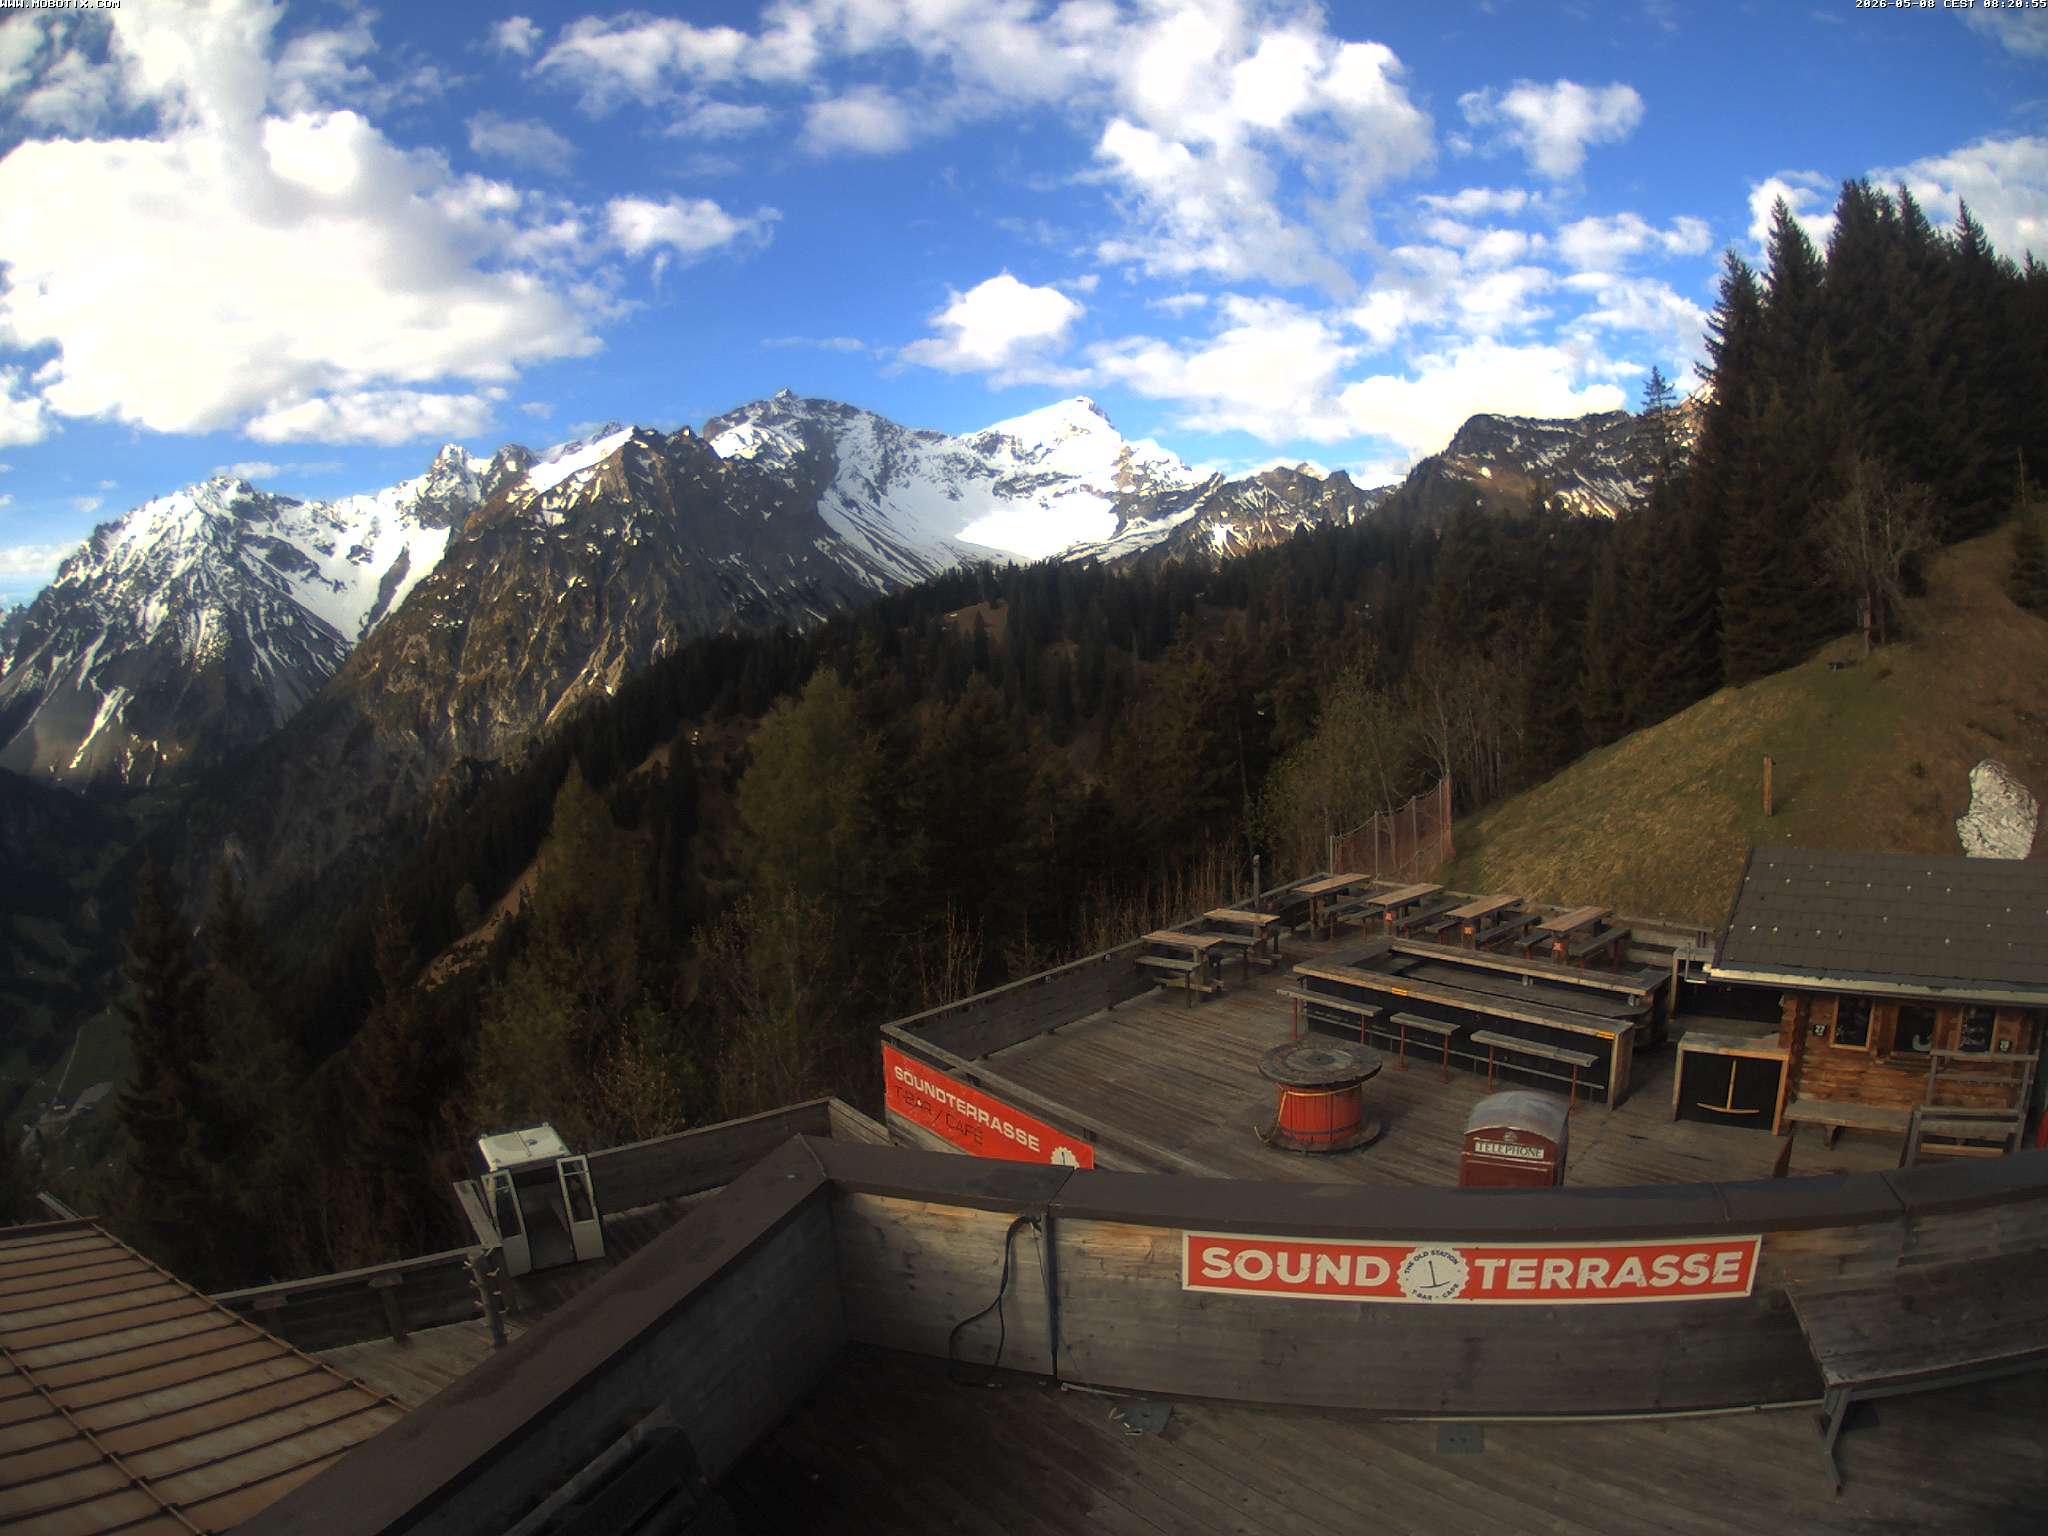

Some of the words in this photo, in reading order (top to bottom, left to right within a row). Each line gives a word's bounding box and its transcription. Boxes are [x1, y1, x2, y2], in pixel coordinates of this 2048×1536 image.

[894, 1065, 1040, 1152] SOUNDTERRASSE
[1477, 1142, 1542, 1158] TELEPHONE
[1201, 1246, 1391, 1287] SOUND
[1474, 1251, 1743, 1289] TERRASSE
[1413, 1251, 1429, 1262] OLD
[1430, 1249, 1458, 1265] STATION
